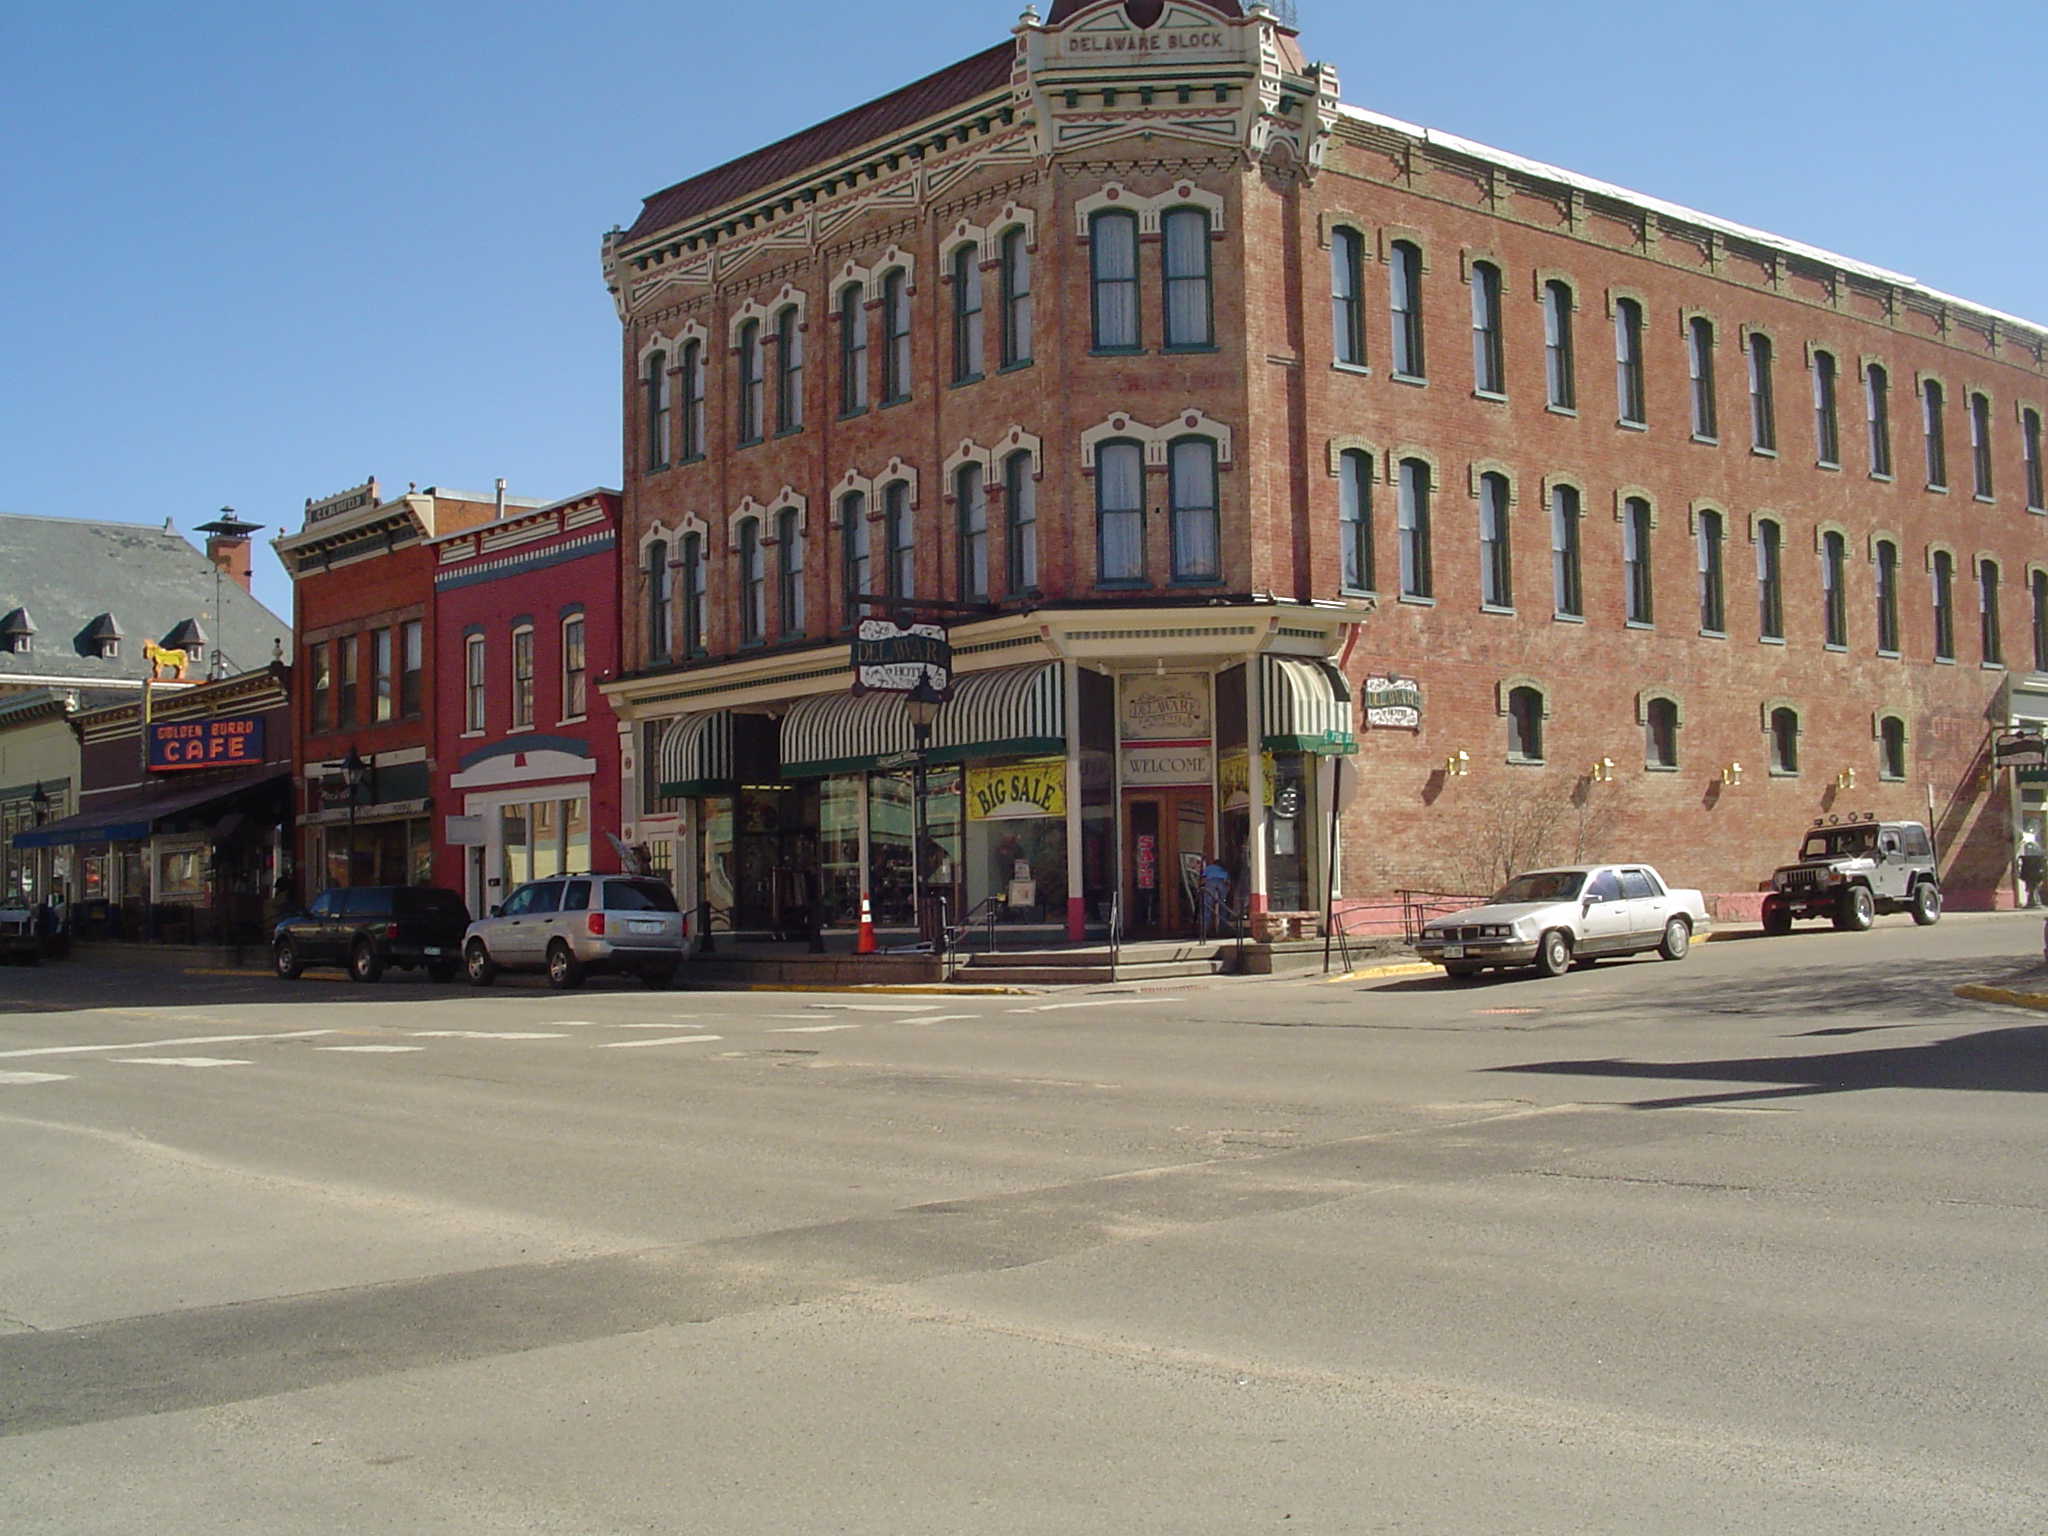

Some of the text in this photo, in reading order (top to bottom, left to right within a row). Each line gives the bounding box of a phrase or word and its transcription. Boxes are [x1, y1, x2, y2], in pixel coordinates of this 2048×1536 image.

[1069, 33, 1222, 51] DELAWARE BLOCK
[1367, 690, 1419, 706] DELAWARE
[1130, 699, 1197, 716] DELAWARE
[157, 721, 254, 740] GOLDEN BURRO
[164, 737, 245, 761] CAFE
[1129, 757, 1205, 773] WELCOME
[977, 775, 1055, 815] BIG SALE
[1138, 835, 1154, 889] SALE
